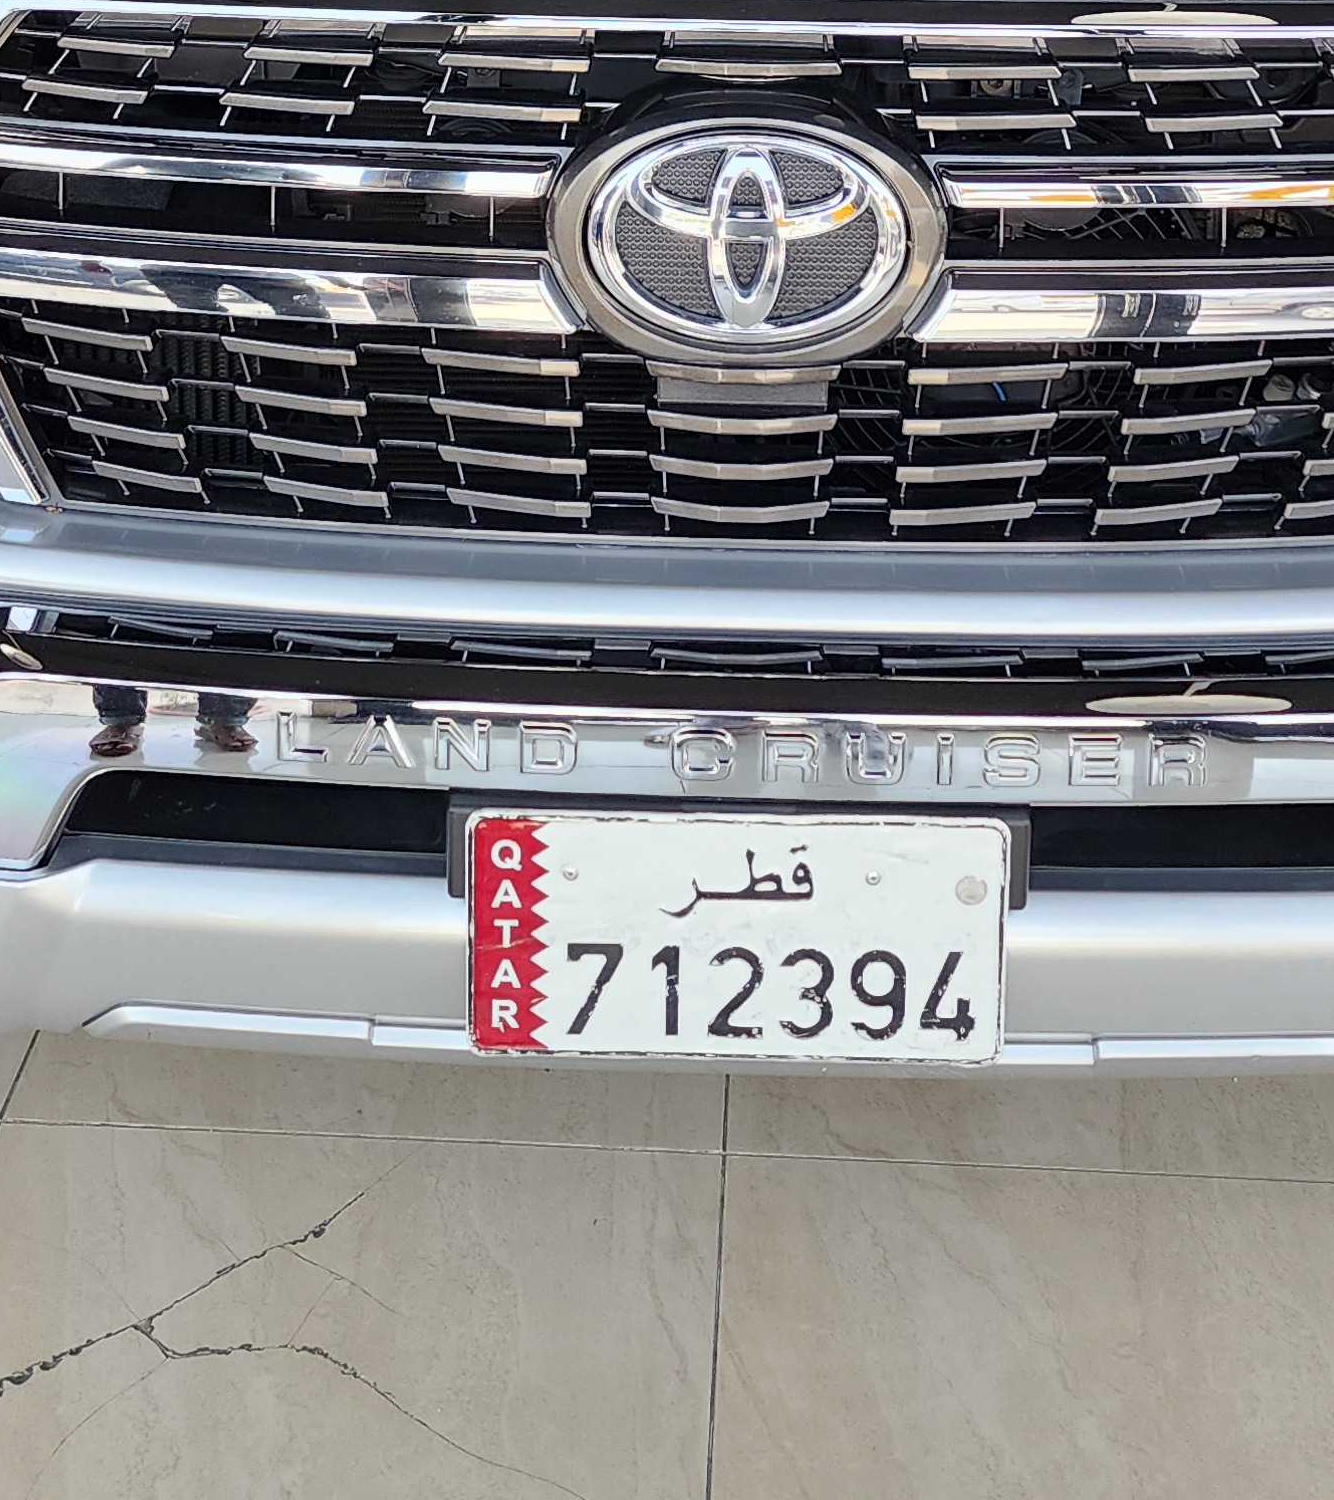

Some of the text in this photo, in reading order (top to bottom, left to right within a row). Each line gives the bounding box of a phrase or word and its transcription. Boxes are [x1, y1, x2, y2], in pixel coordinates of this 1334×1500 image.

[276, 710, 1208, 788] LAND CRUISER
[659, 844, 814, 917] قطر
[488, 837, 524, 1032] QATAR
[565, 942, 977, 1042] 712394
